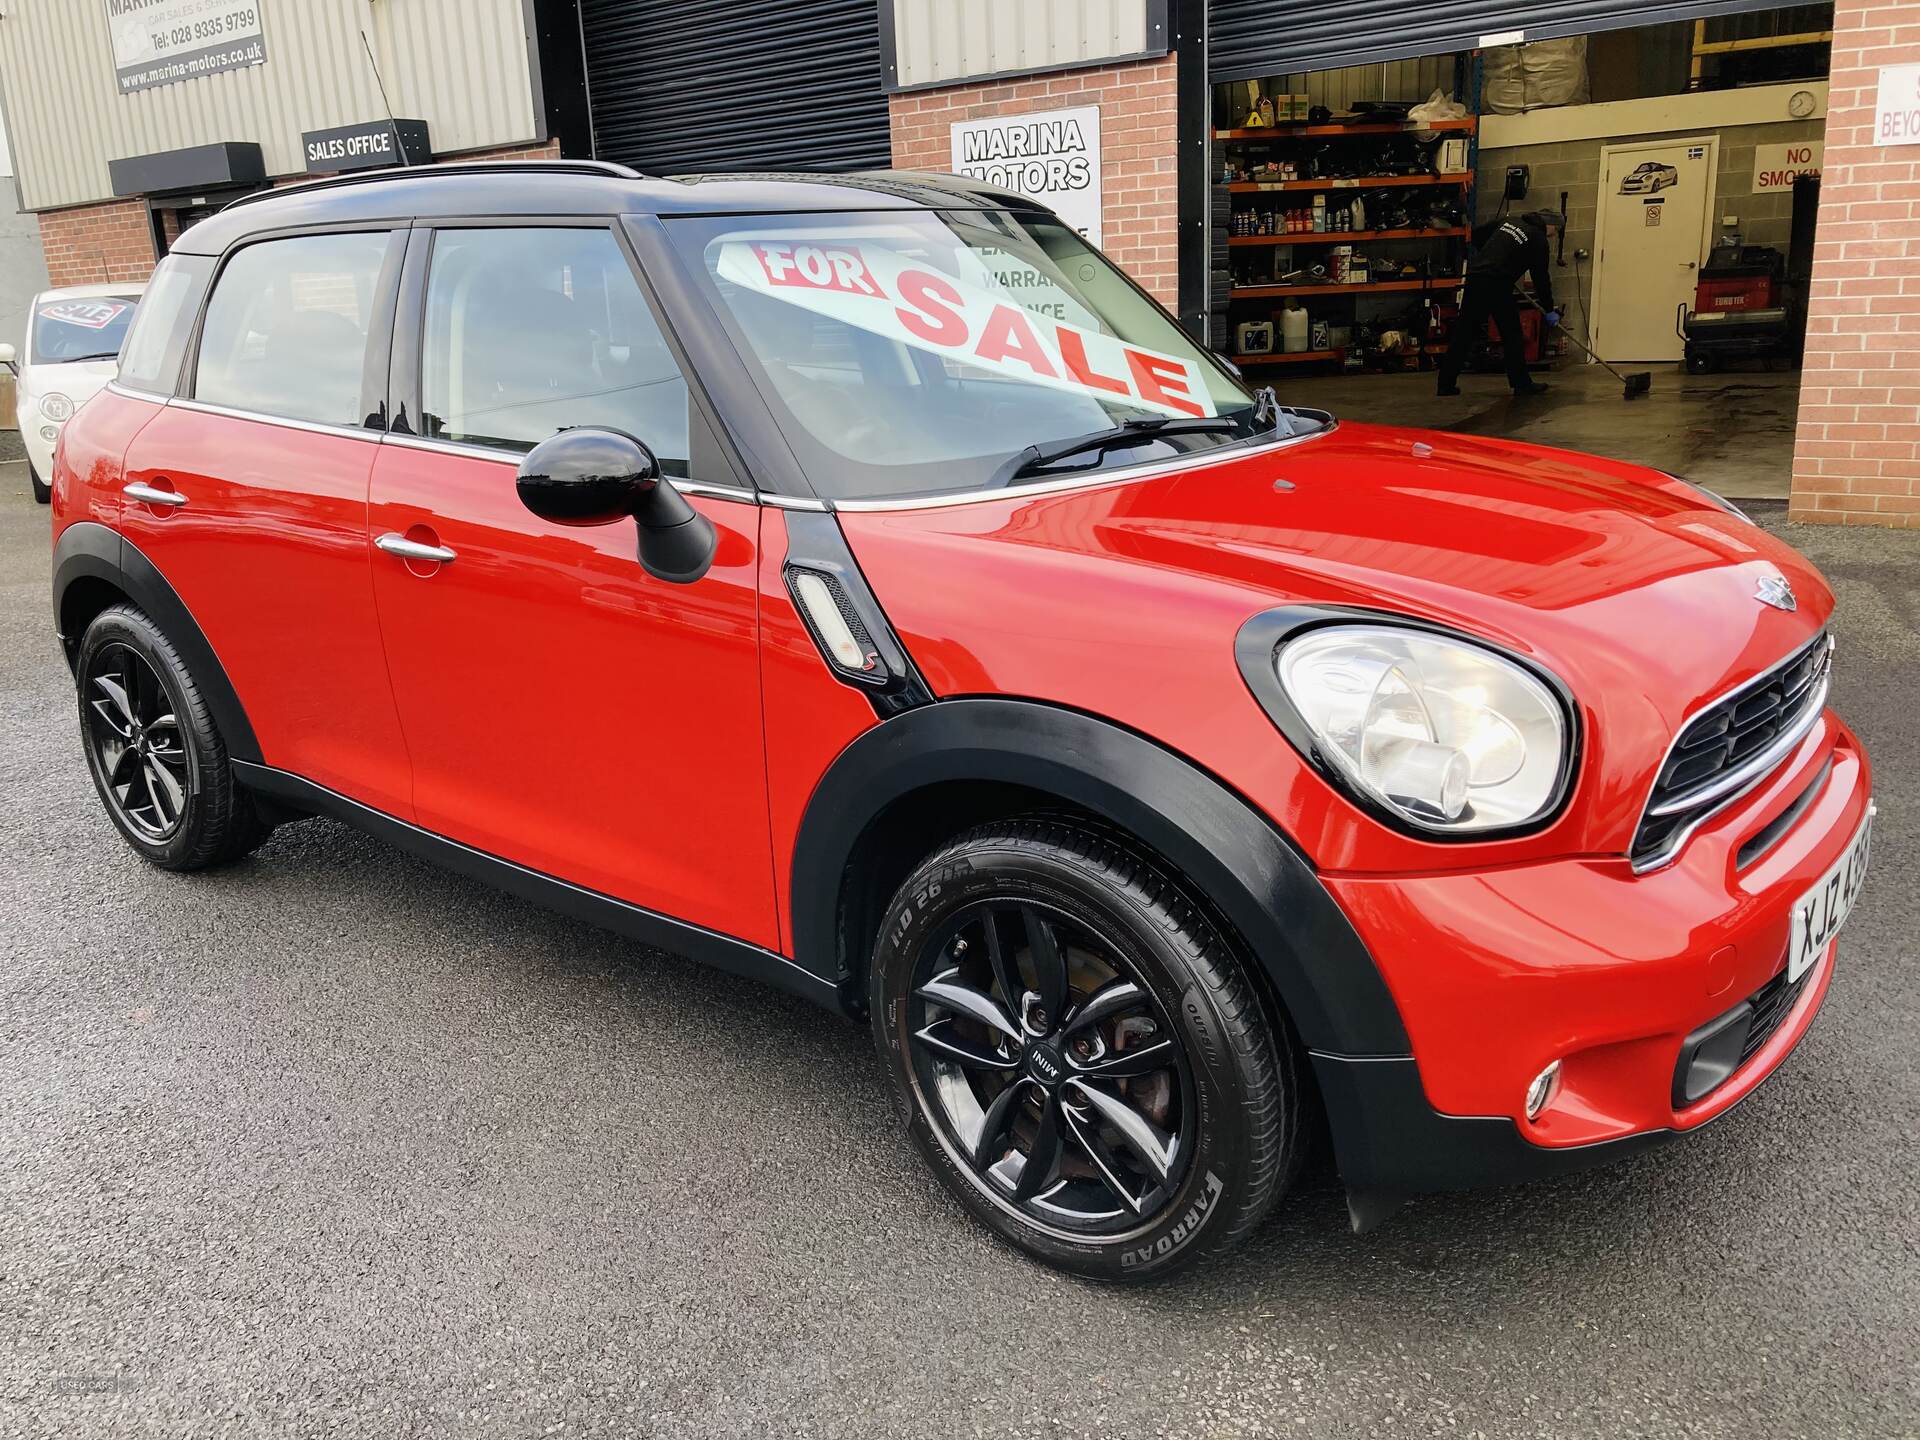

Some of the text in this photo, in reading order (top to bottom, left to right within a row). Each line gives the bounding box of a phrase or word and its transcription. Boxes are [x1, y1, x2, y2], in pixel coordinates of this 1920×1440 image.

[151, 8, 255, 51] Tel: 028 9335 9799
[167, 6, 194, 21] SALES
[121, 42, 263, 89] www.marina-motors.co.uk
[308, 132, 391, 161] SALES OFFICE
[963, 119, 1086, 162] MARINA
[1786, 147, 1812, 165] NO
[52, 303, 113, 321] SALE
[761, 242, 1206, 418] FOR SALE
[915, 882, 942, 911] 26
[1800, 870, 1841, 963] XJZ
[1032, 1049, 1060, 1078] MINI
[1120, 1169, 1224, 1267] FARROAD
